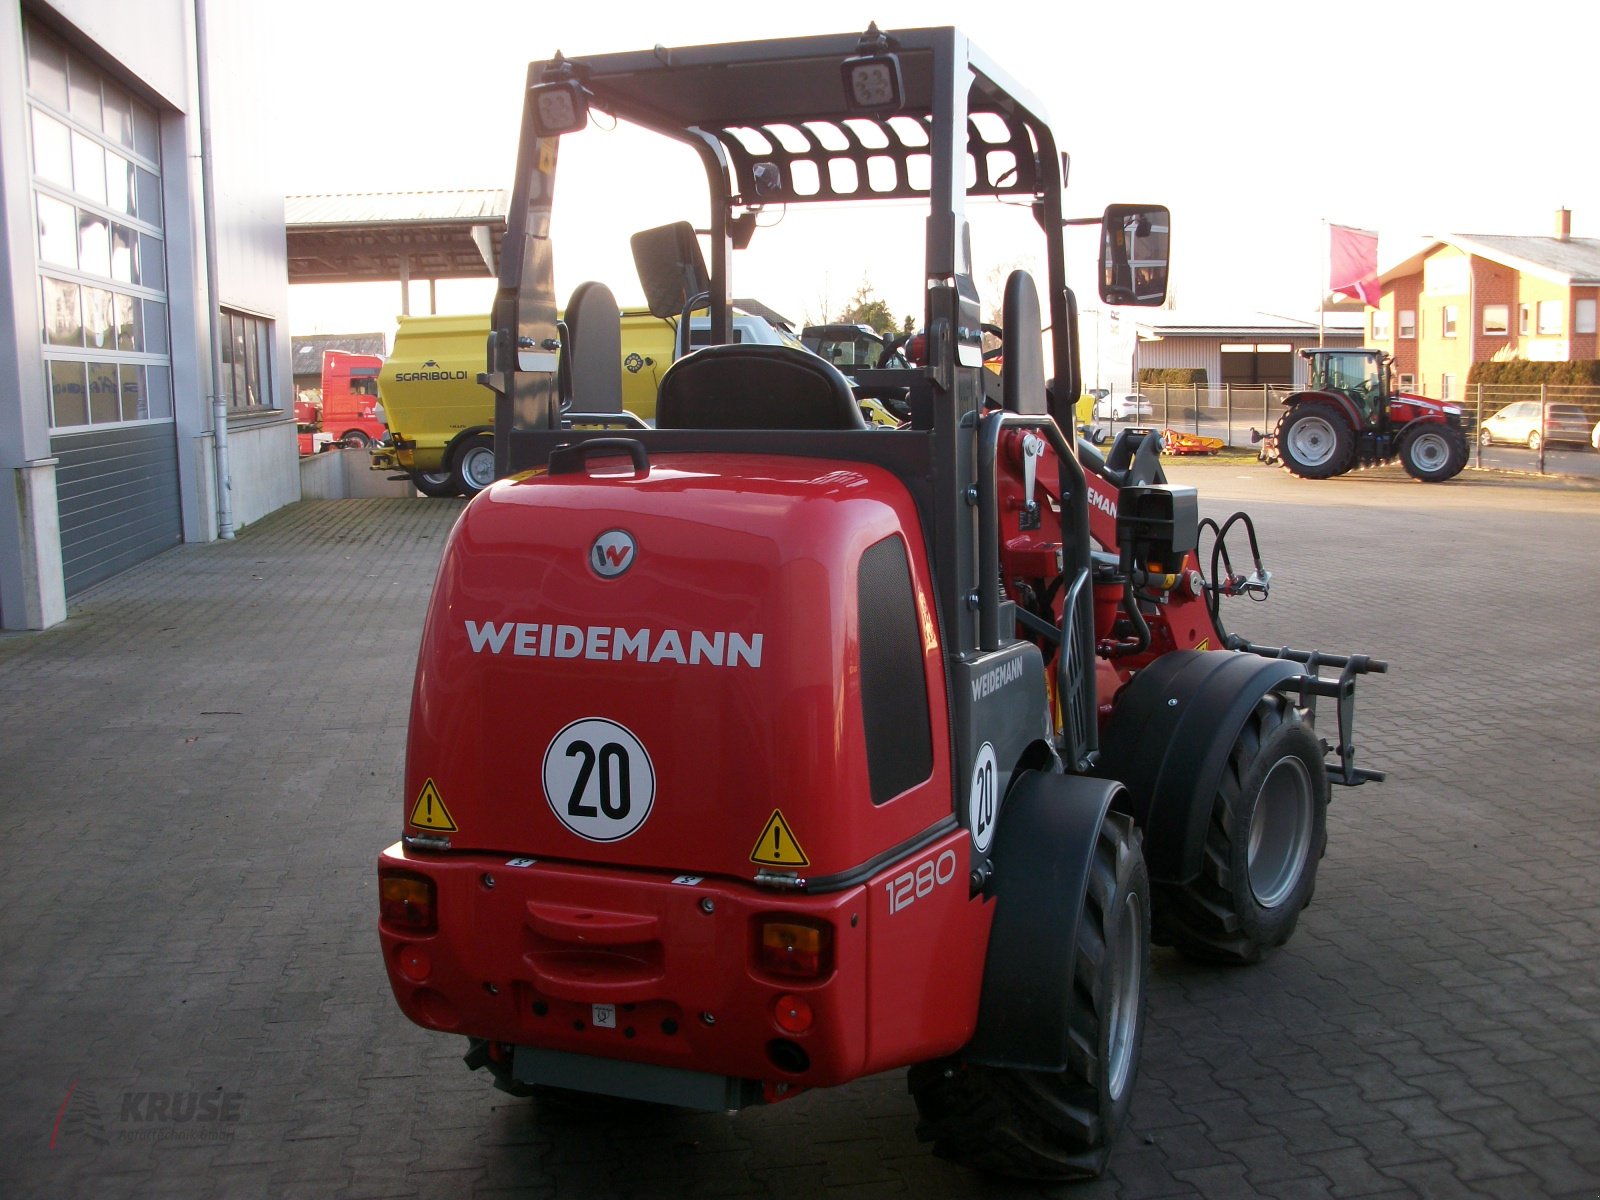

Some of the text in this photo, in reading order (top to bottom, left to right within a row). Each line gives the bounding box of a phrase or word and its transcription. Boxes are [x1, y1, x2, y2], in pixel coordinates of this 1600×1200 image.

[395, 371, 468, 382] SGARIBOLDI
[464, 619, 764, 668] WEIDEMANN
[970, 655, 1023, 702] WEIDEMANN
[566, 740, 631, 820] 20
[977, 759, 993, 836] 20
[886, 849, 956, 915] 1280
